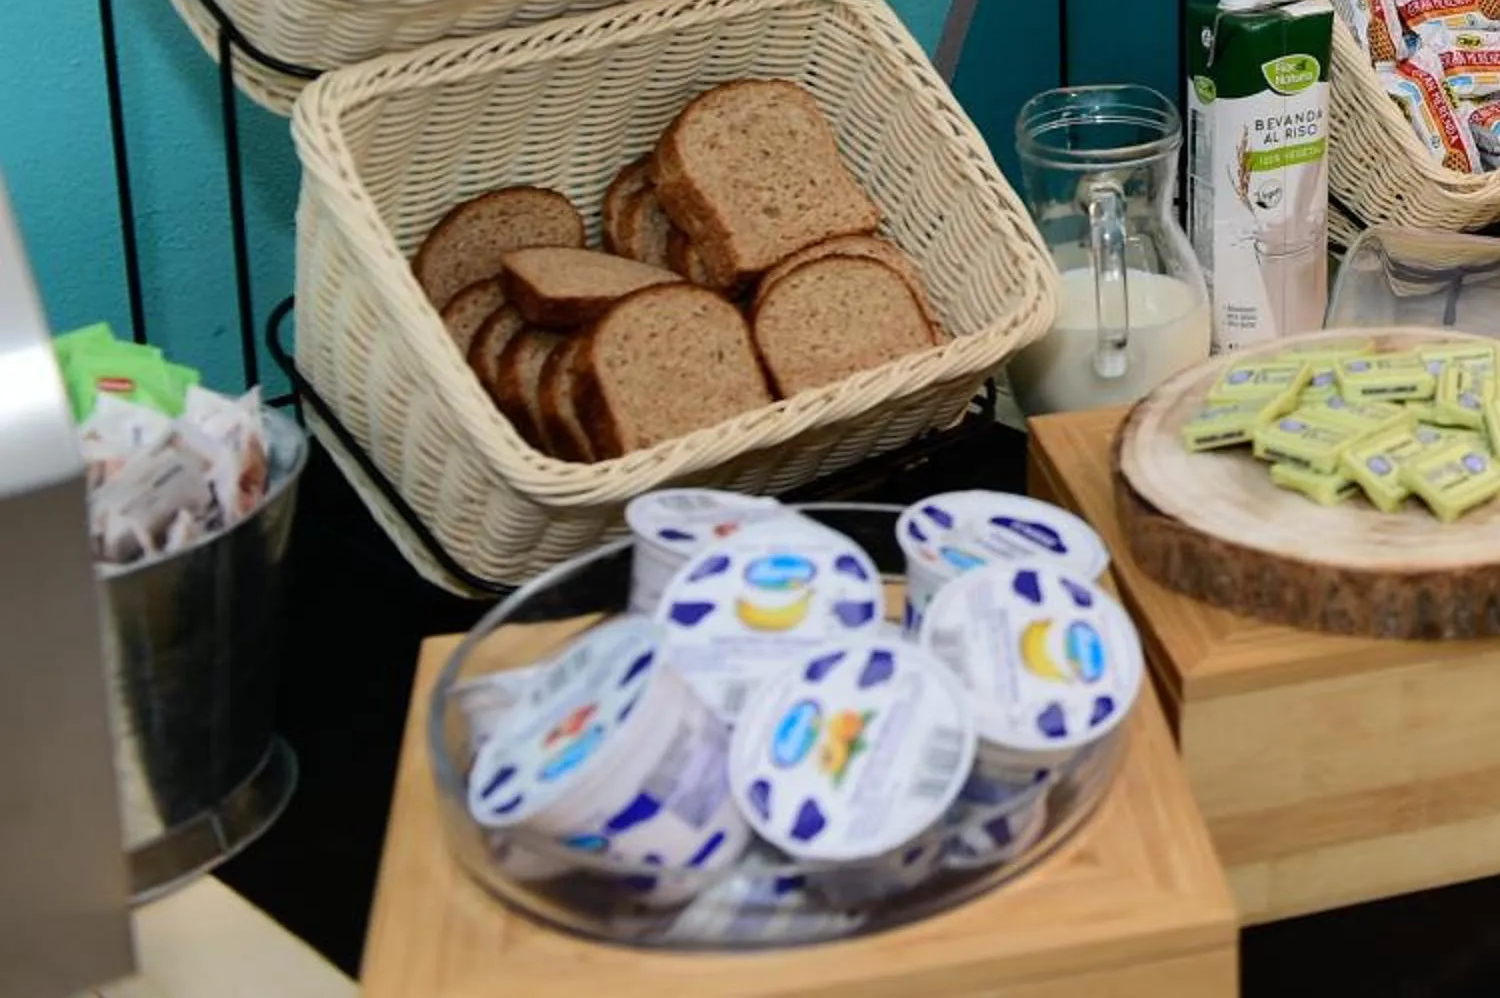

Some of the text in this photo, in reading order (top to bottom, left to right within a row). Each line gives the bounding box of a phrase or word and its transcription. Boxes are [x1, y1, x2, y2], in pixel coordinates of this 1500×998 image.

[1255, 109, 1324, 131] BEVANDA
[1263, 123, 1319, 145] AL RISO
